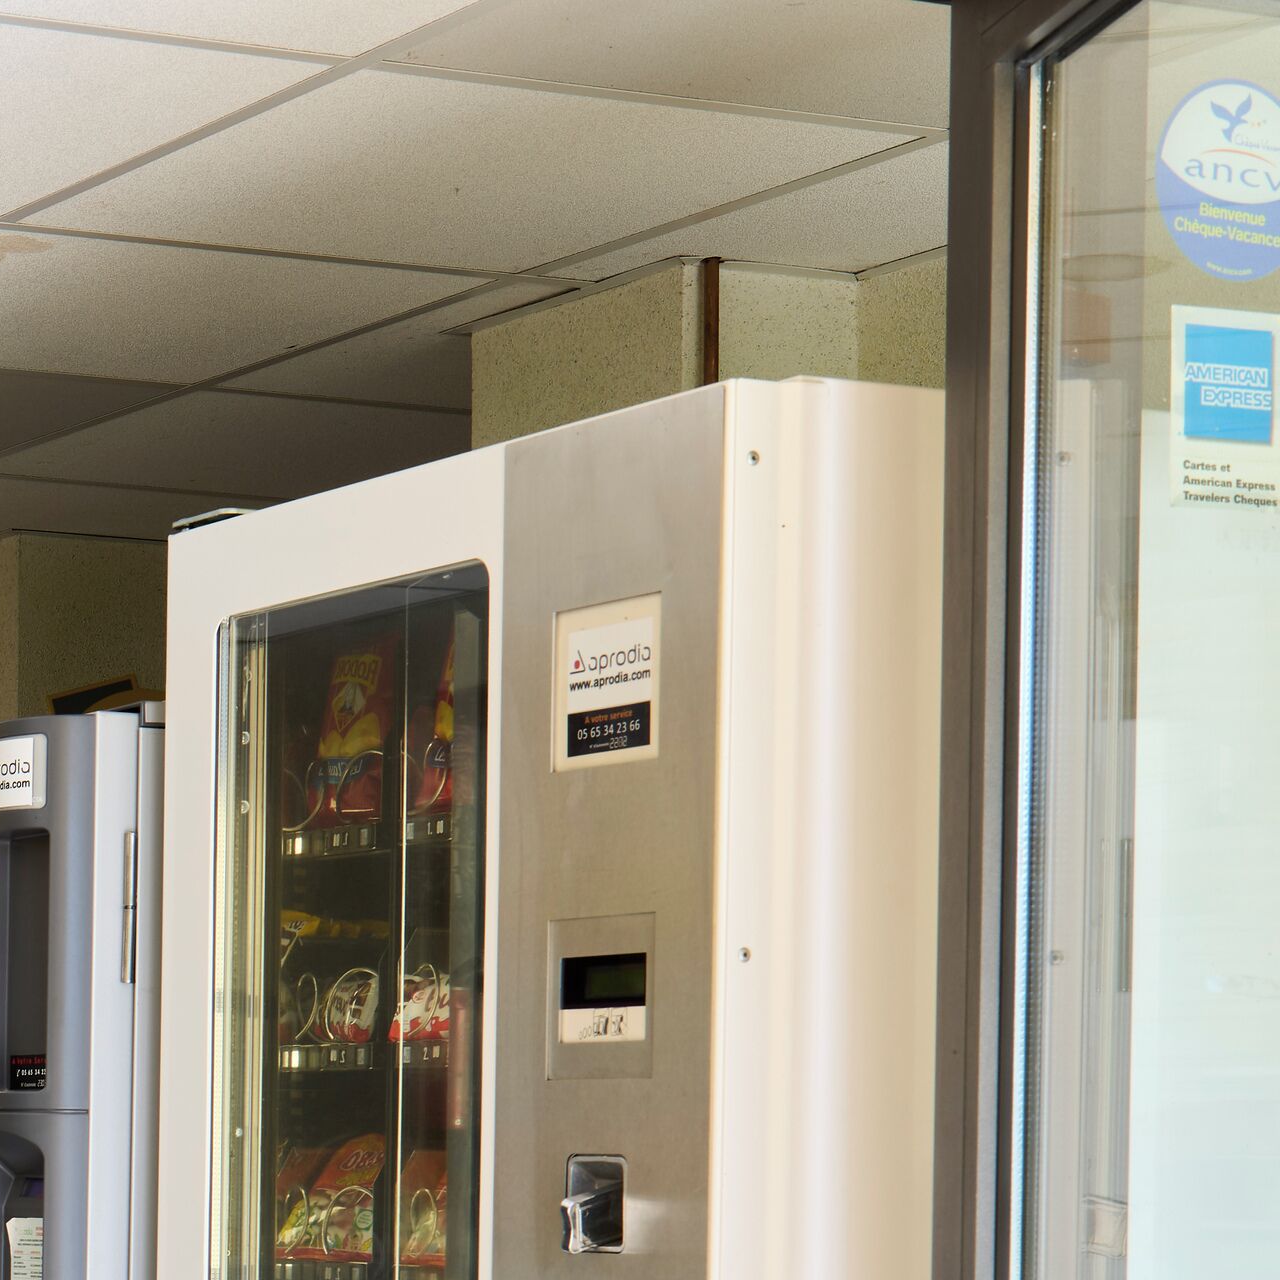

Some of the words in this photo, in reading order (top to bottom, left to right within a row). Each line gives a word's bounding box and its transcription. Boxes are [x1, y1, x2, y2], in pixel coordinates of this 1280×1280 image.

[1185, 158, 1280, 190] ancv
[1200, 202, 1265, 226] Bienvenue
[1185, 363, 1266, 385] AMERICAN
[1203, 388, 1272, 408] EXPRESS
[1183, 460, 1216, 472] Cartes
[1220, 463, 1230, 472] et
[1183, 475, 1232, 488] American
[1236, 479, 1276, 494] Express
[1183, 491, 1230, 504] Travelers
[1233, 494, 1279, 508] Cheques
[588, 643, 651, 675] aprodia
[569, 668, 651, 692] www.aprodia.com
[610, 709, 633, 722] service
[577, 728, 588, 740] 05
[591, 725, 601, 738] 65
[603, 723, 614, 736] 34
[616, 721, 627, 734] 23
[629, 719, 640, 732] 66
